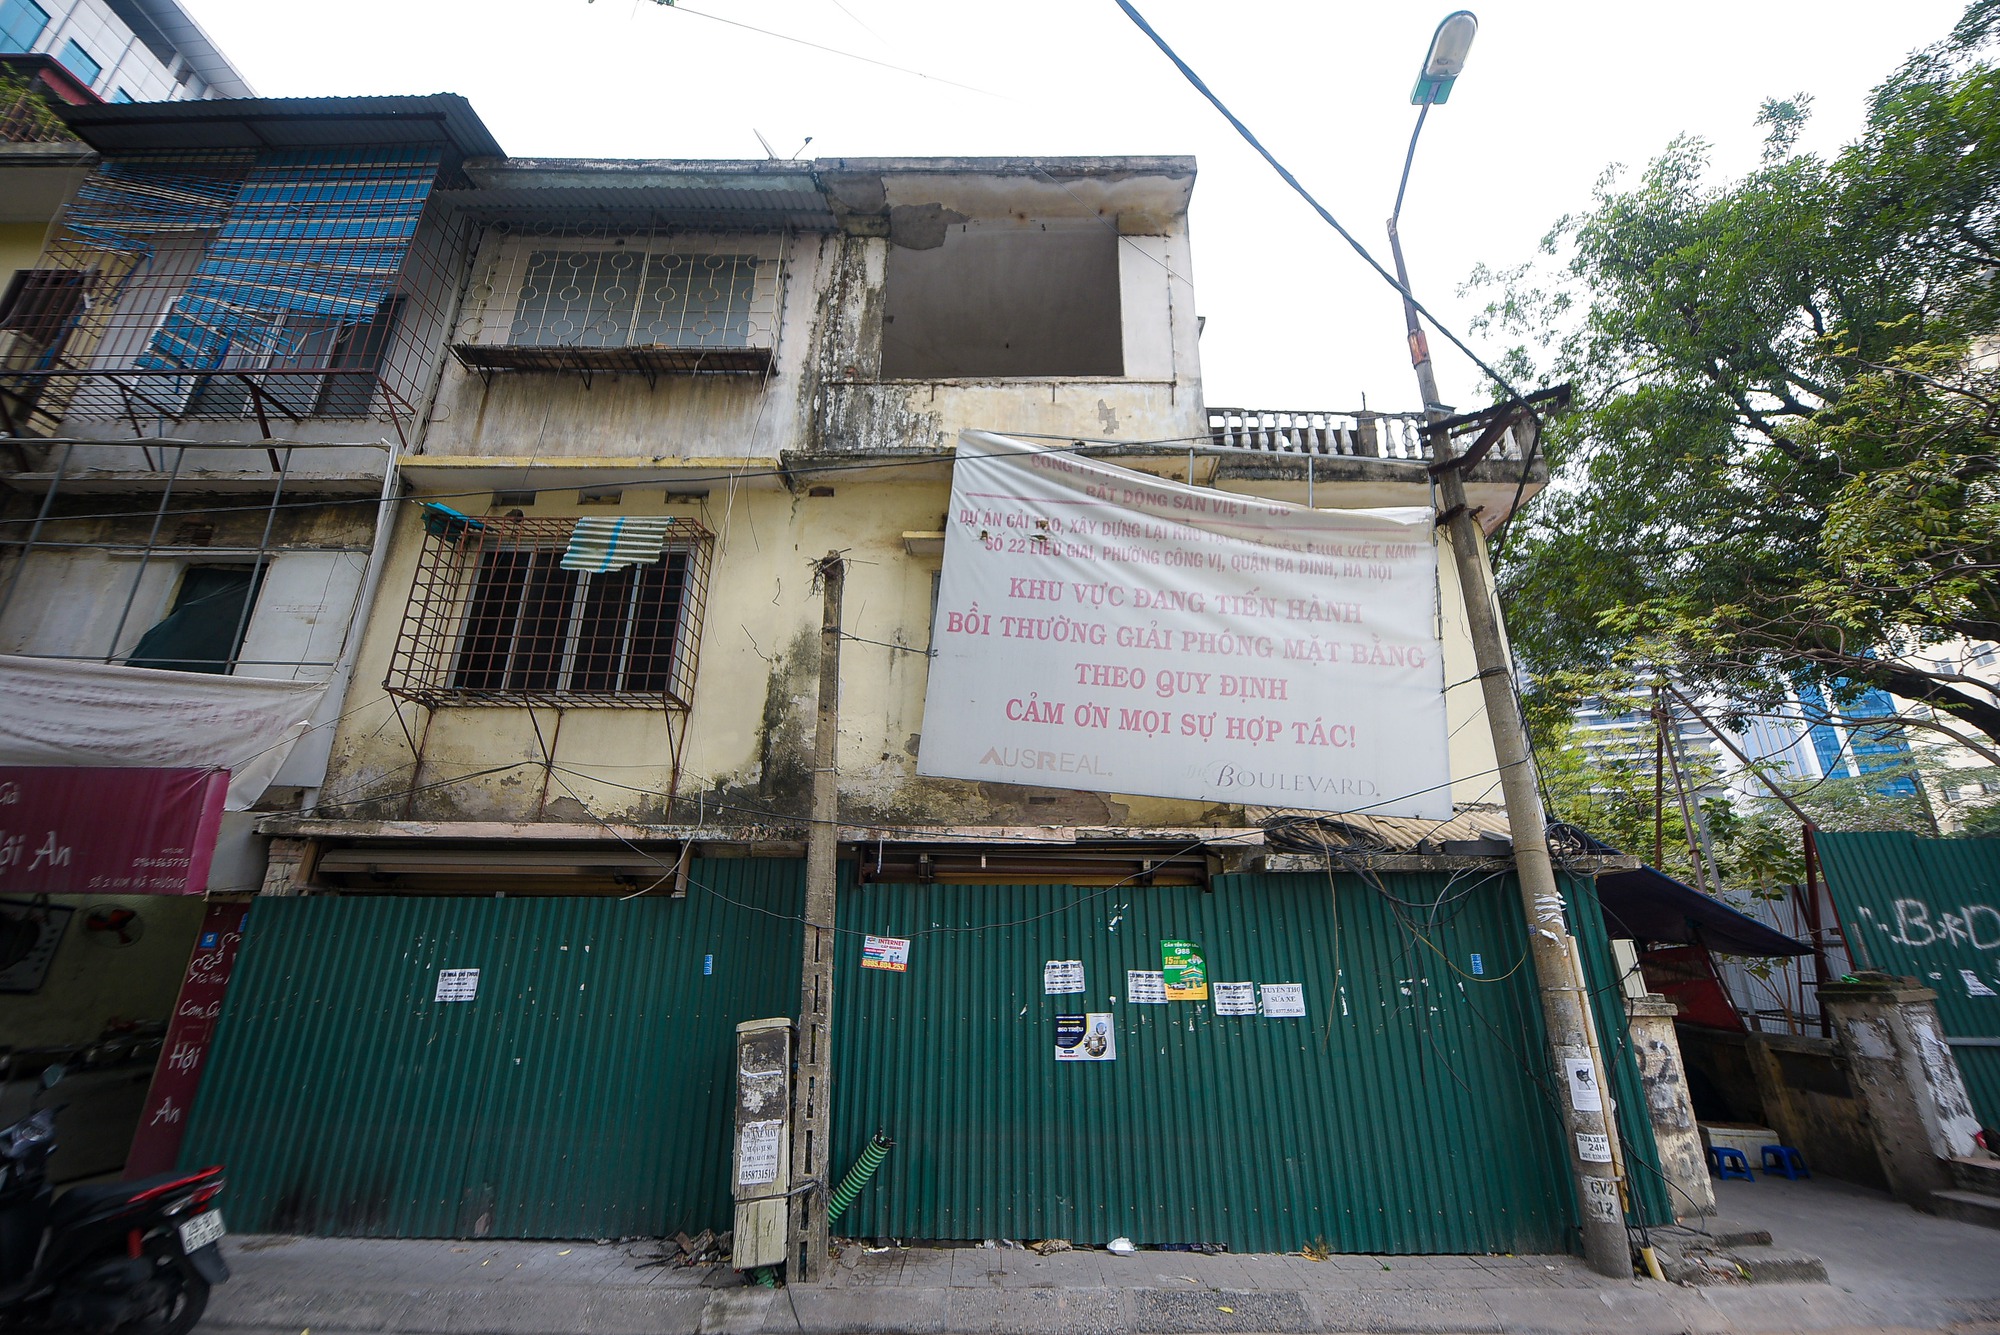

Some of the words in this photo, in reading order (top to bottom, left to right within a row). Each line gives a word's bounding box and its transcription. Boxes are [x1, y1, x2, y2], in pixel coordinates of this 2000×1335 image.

[1123, 489, 1168, 508] ĐỘNG
[960, 507, 980, 527] DỰ
[983, 507, 1003, 526] ÁN
[1006, 508, 1030, 530] CẢI
[1069, 516, 1098, 535] XÂY
[1102, 519, 1141, 541] DỰNG
[1145, 525, 1169, 542] LẠI
[1350, 541, 1378, 559] VIỆT
[1386, 545, 1417, 558] NAM
[984, 531, 1006, 551] SỐ
[1008, 537, 1026, 553] 22
[1103, 545, 1160, 565] PHƯỜNG
[1165, 547, 1203, 568] CÔNG
[1208, 552, 1226, 573] VỊ,
[1231, 551, 1270, 574] QUẬN
[1275, 557, 1294, 573] BA
[1368, 561, 1393, 582] NỘI
[1008, 576, 1065, 602] KHU
[1072, 582, 1125, 610] VỰC
[1133, 587, 1206, 614] ĐANG
[1215, 586, 1278, 618] TIẾN
[1286, 593, 1364, 624] HÀNH
[946, 601, 992, 636] BỒI
[1000, 614, 1108, 646] THƯỜNG
[1116, 619, 1173, 650] GIẢI
[1182, 627, 1274, 659] PHÓNG
[1282, 633, 1341, 667] MẶT
[1351, 632, 1427, 669] BẰNG
[1074, 663, 1147, 690] THEO
[1155, 669, 1212, 699] QUY
[1219, 674, 1289, 703] ĐỊNH
[1005, 691, 1066, 725] CẢM
[1074, 702, 1111, 729] ƠN
[1118, 707, 1172, 738] MỌI
[1180, 711, 1218, 743] SỰ
[1225, 715, 1284, 747] HỢP
[1291, 716, 1357, 749] TÁC!
[1164, 955, 1174, 965] 15
[168, 1042, 201, 1077] Hội
[1588, 1143, 1606, 1152] 24H
